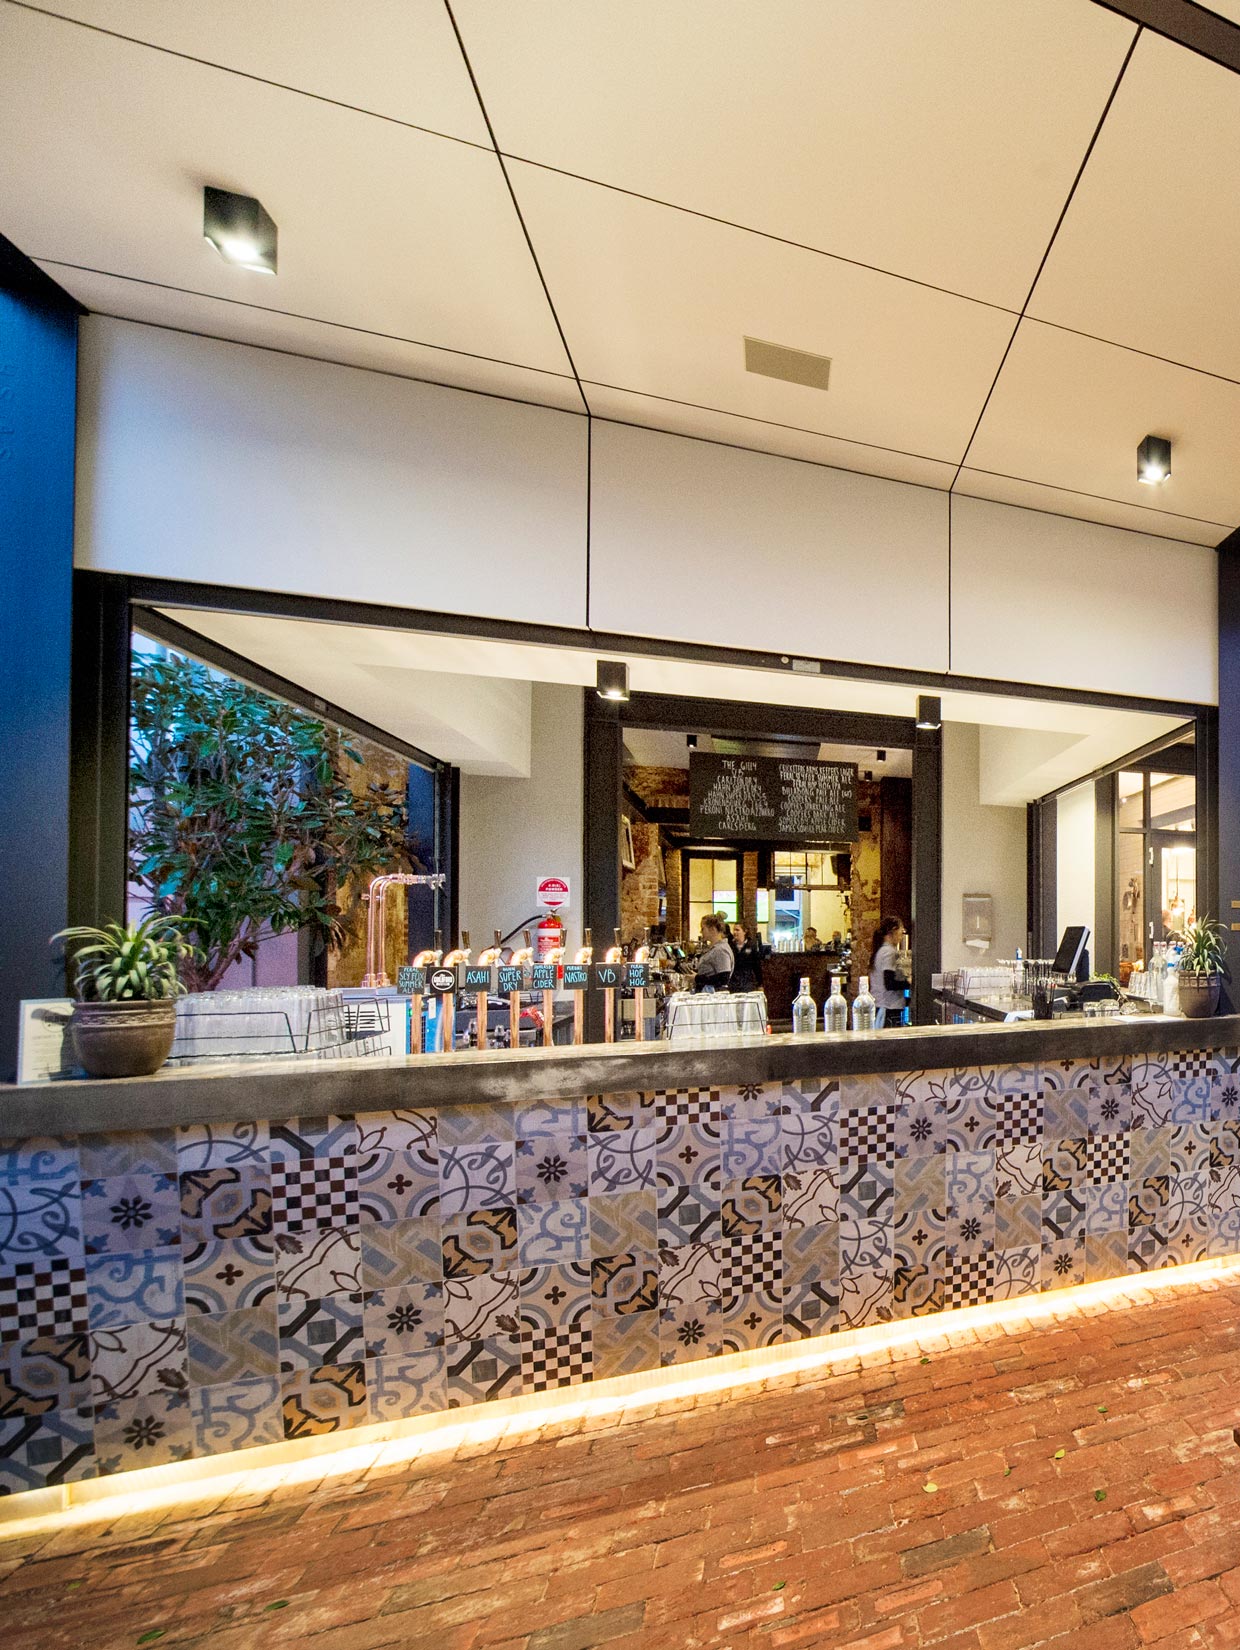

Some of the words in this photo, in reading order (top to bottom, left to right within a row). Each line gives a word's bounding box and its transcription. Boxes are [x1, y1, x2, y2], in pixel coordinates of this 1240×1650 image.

[722, 760, 735, 769] THE
[466, 970, 490, 984] ASAHI
[499, 970, 521, 983] SUPER
[533, 969, 554, 979] APPLE
[565, 972, 587, 983] NASTRO
[598, 968, 616, 983] VB
[629, 969, 644, 978] HOP
[399, 980, 423, 988] SUMMER
[503, 982, 518, 992] DRY
[533, 979, 555, 989] CIDER
[629, 978, 646, 987] HOG
